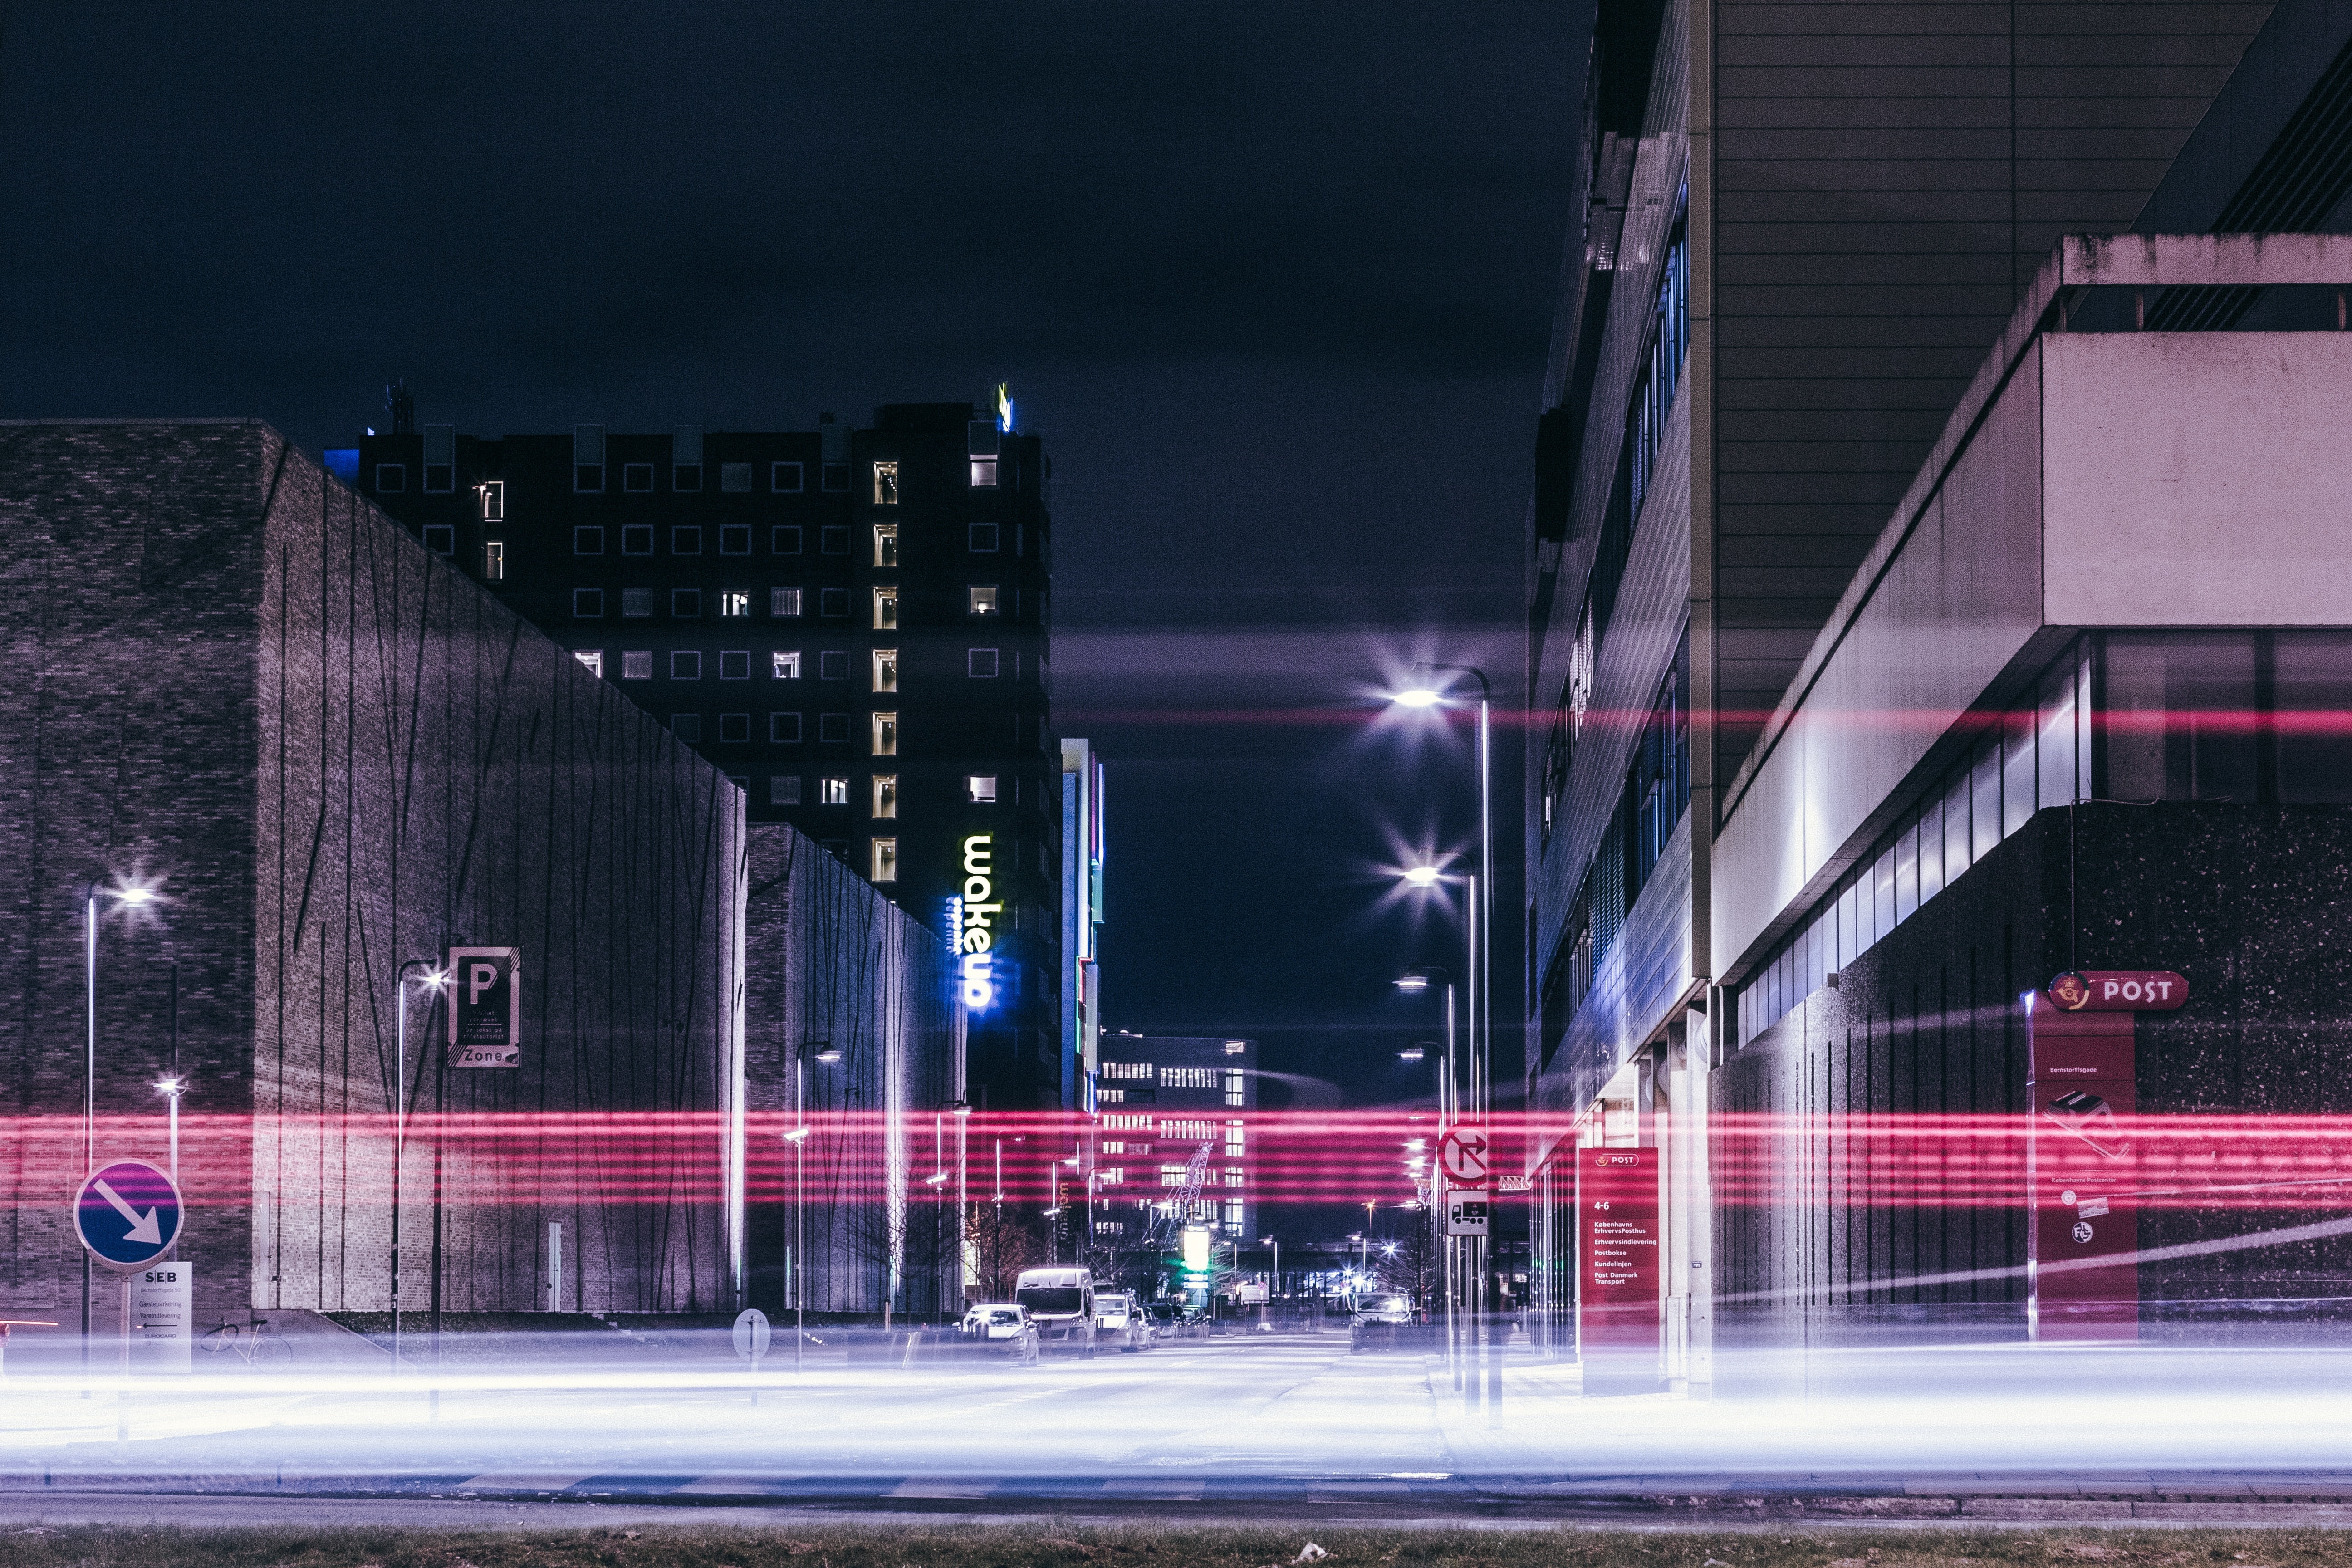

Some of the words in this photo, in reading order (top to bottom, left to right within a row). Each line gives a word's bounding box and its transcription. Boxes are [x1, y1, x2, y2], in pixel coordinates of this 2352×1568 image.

[964, 836, 1001, 1007] wakeup
[470, 964, 498, 1004] P
[2104, 981, 2173, 1003] POST
[464, 1049, 502, 1061] Zone
[1594, 1201, 1609, 1210] 4-6
[145, 1272, 176, 1283] SEB
